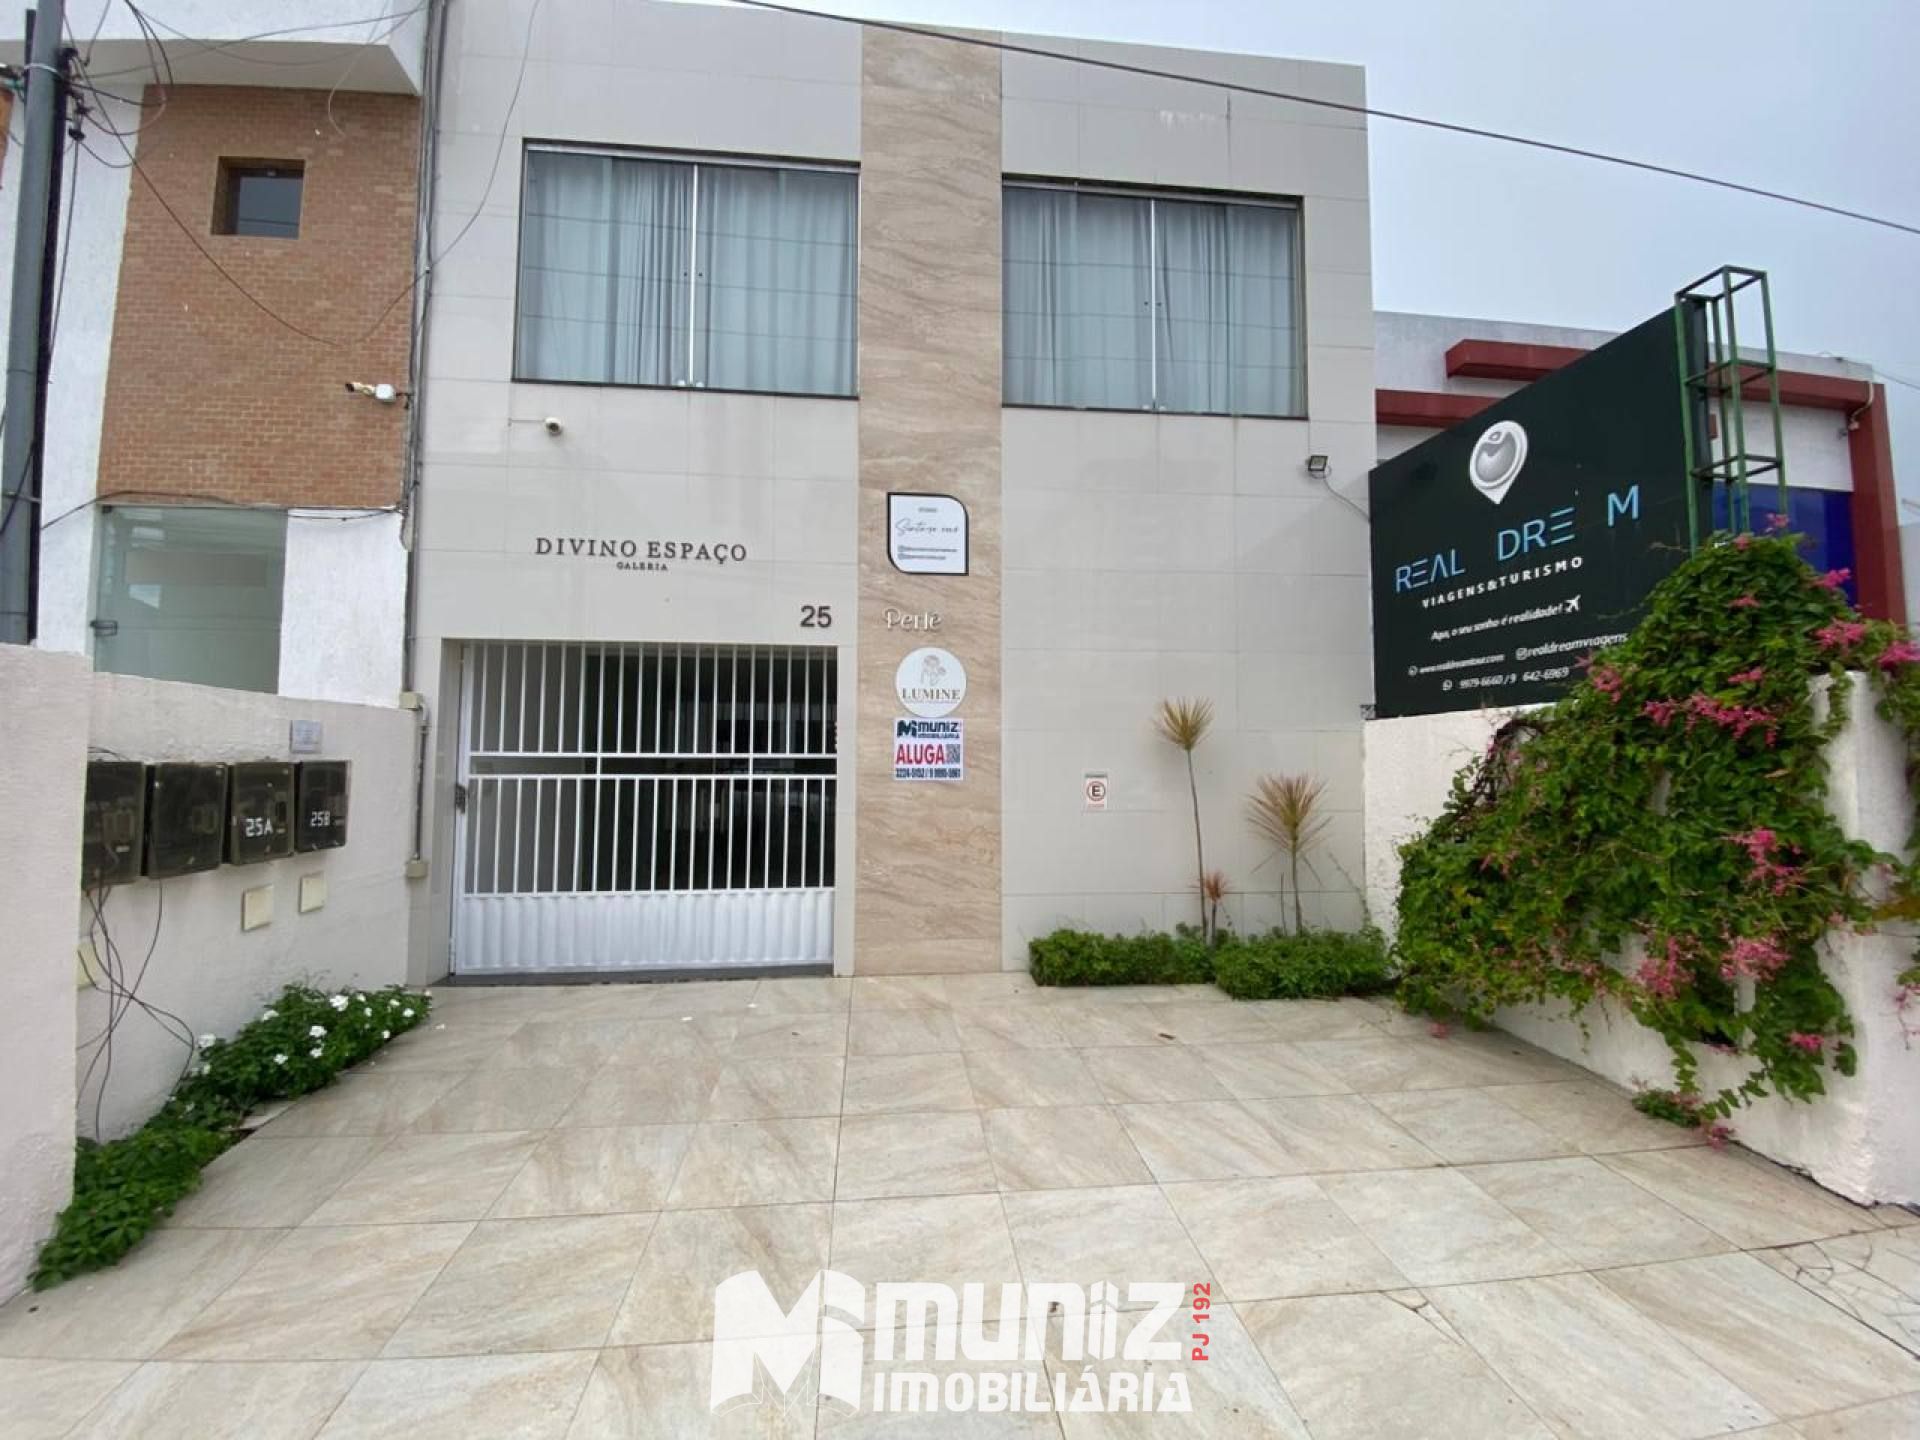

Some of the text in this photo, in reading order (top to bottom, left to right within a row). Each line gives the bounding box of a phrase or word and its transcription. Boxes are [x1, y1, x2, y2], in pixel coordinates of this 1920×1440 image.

[536, 537, 748, 564] DIVINO ESPAÇO
[616, 561, 668, 571] GALERIA
[1396, 549, 1466, 593] REAL
[800, 605, 832, 628] 25
[902, 688, 961, 700] LUMINE
[896, 743, 945, 765] ALUGA
[245, 818, 273, 837] 25A
